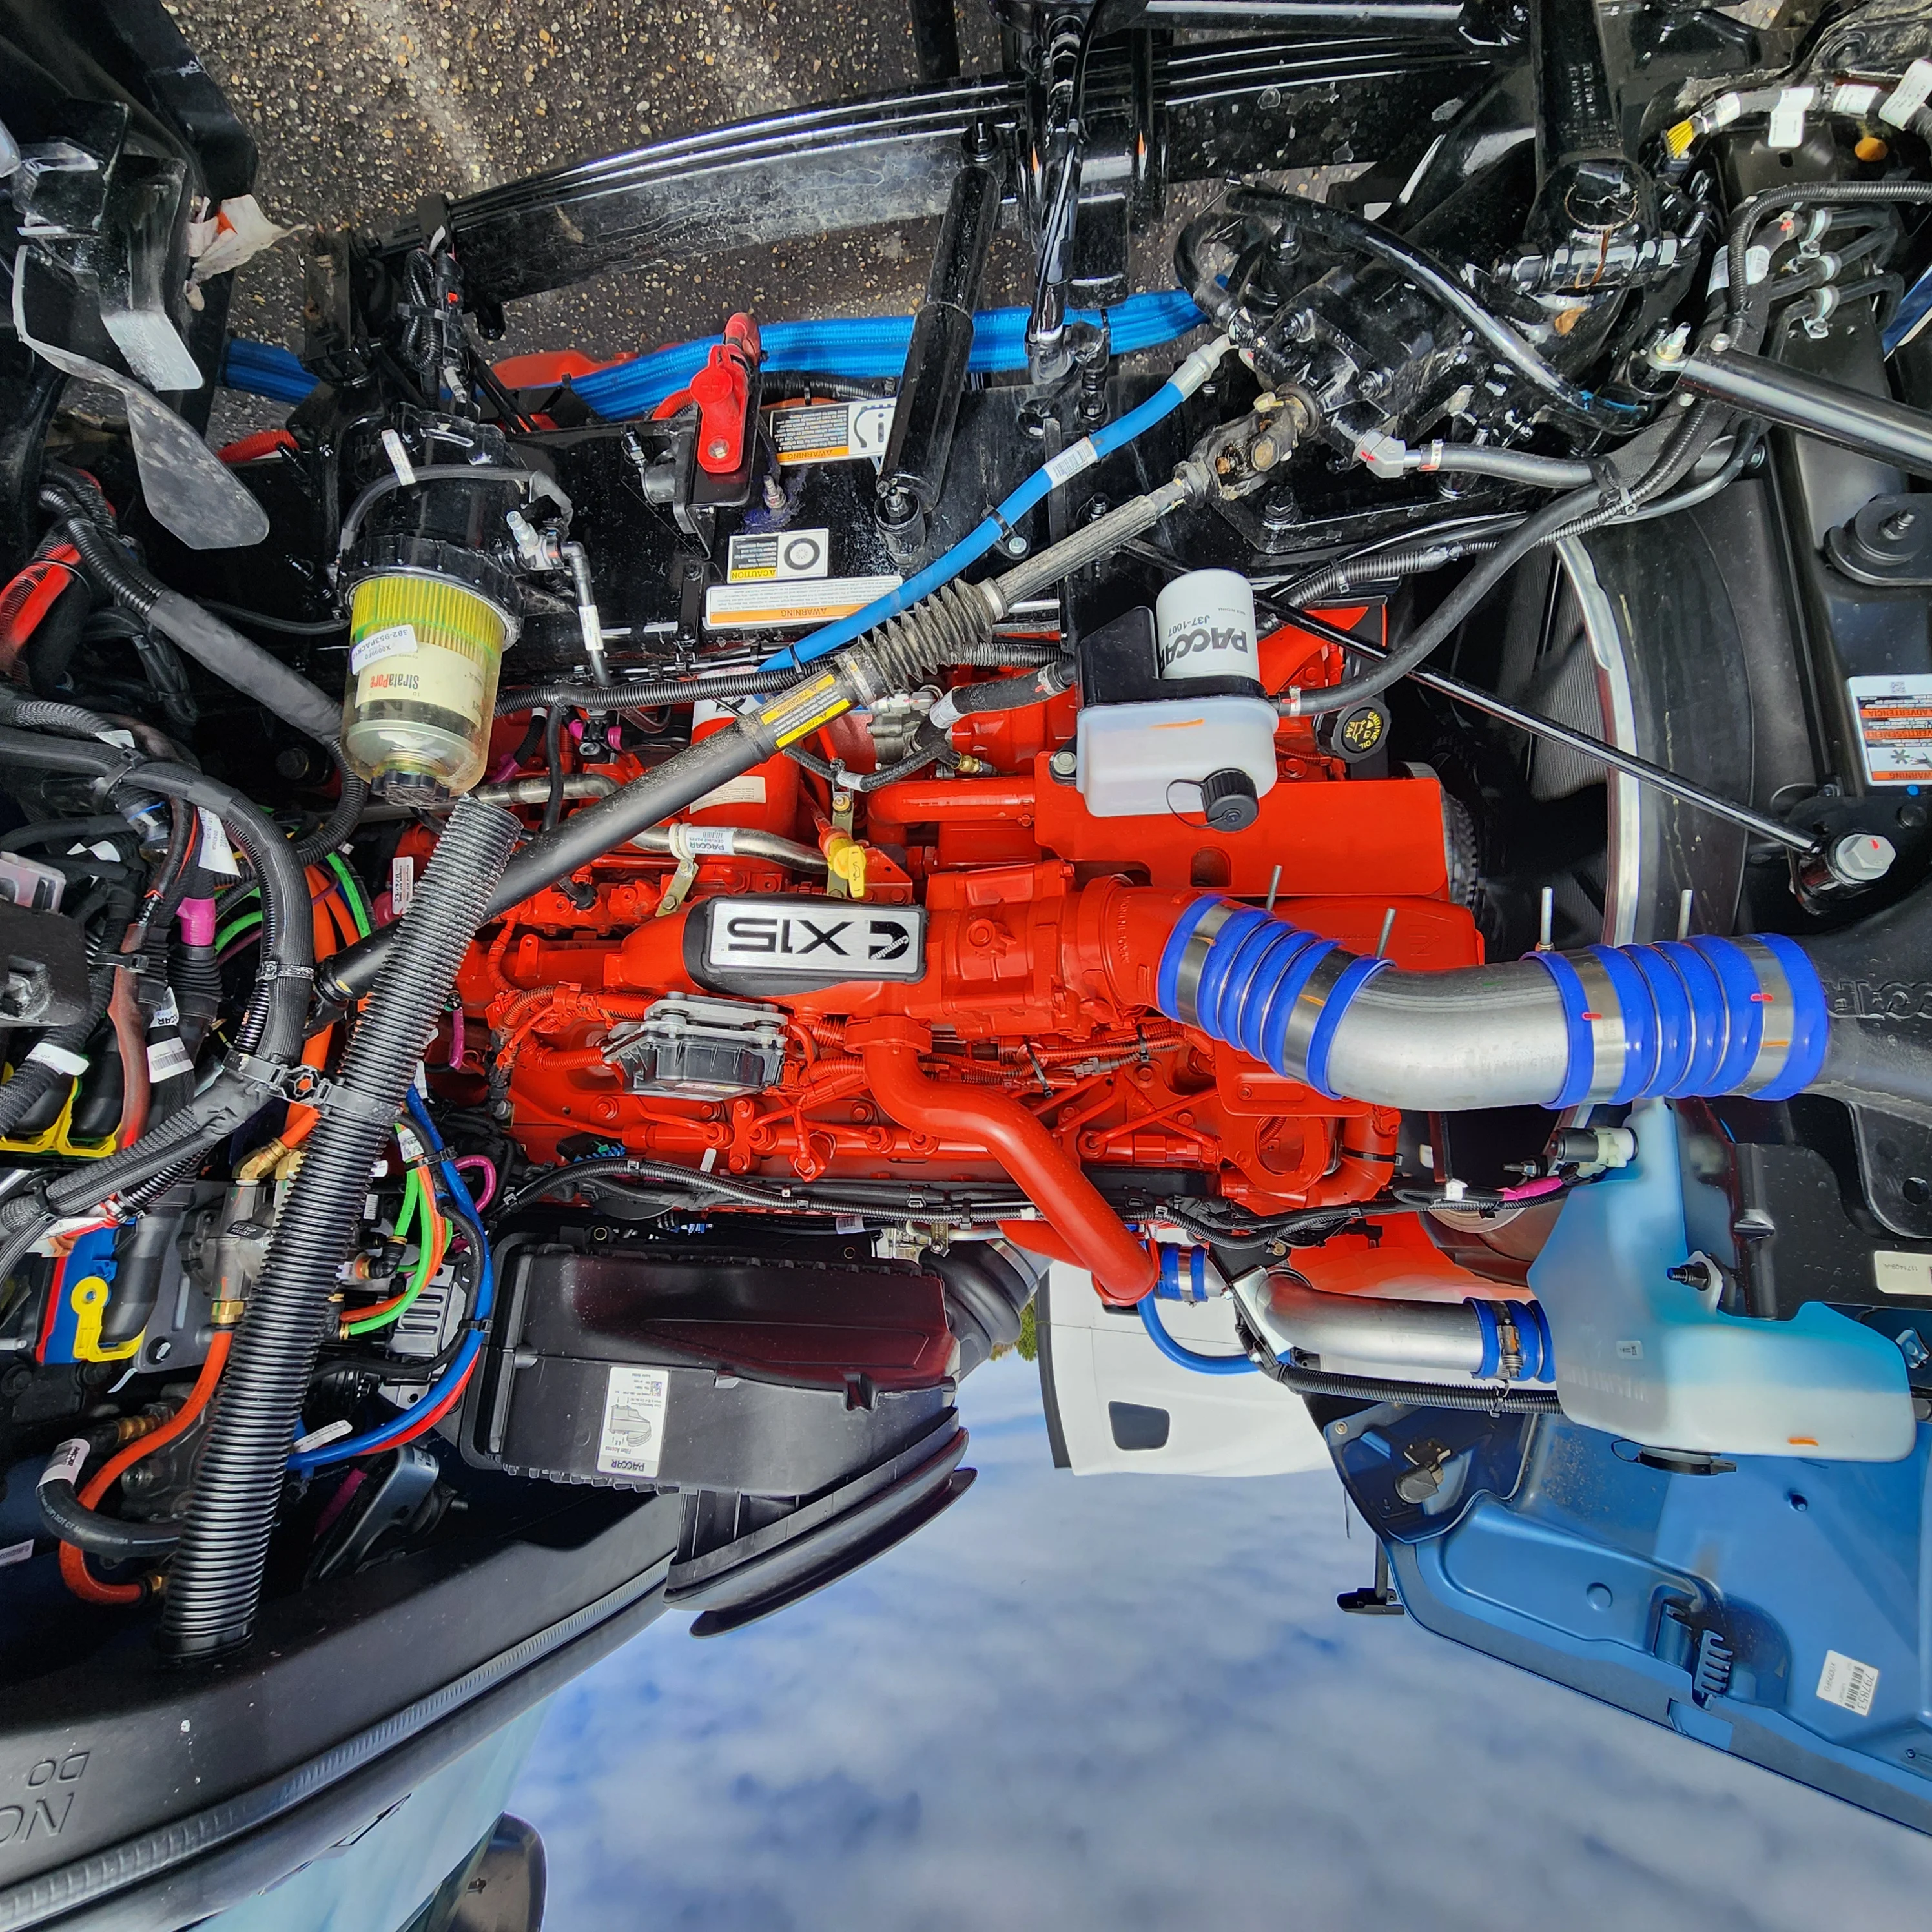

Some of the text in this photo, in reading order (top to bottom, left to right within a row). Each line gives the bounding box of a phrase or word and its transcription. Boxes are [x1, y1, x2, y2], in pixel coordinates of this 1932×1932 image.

[787, 450, 826, 460] WARNING
[731, 571, 769, 579] CAUTION
[781, 608, 821, 617] WARNING
[1167, 615, 1211, 639] J37-1007
[369, 673, 420, 690] StrataPore
[797, 719, 818, 734] CAUTION
[1345, 721, 1355, 739] FA4
[1358, 711, 1381, 750] ENGINE OIL
[690, 841, 724, 850] PACCAR
[726, 917, 855, 956] X15
[870, 935, 909, 960] Cummins
[610, 1459, 645, 1472] PACCAR
[1856, 1672, 1875, 1711] 797853
[26, 1752, 90, 1790] DO
